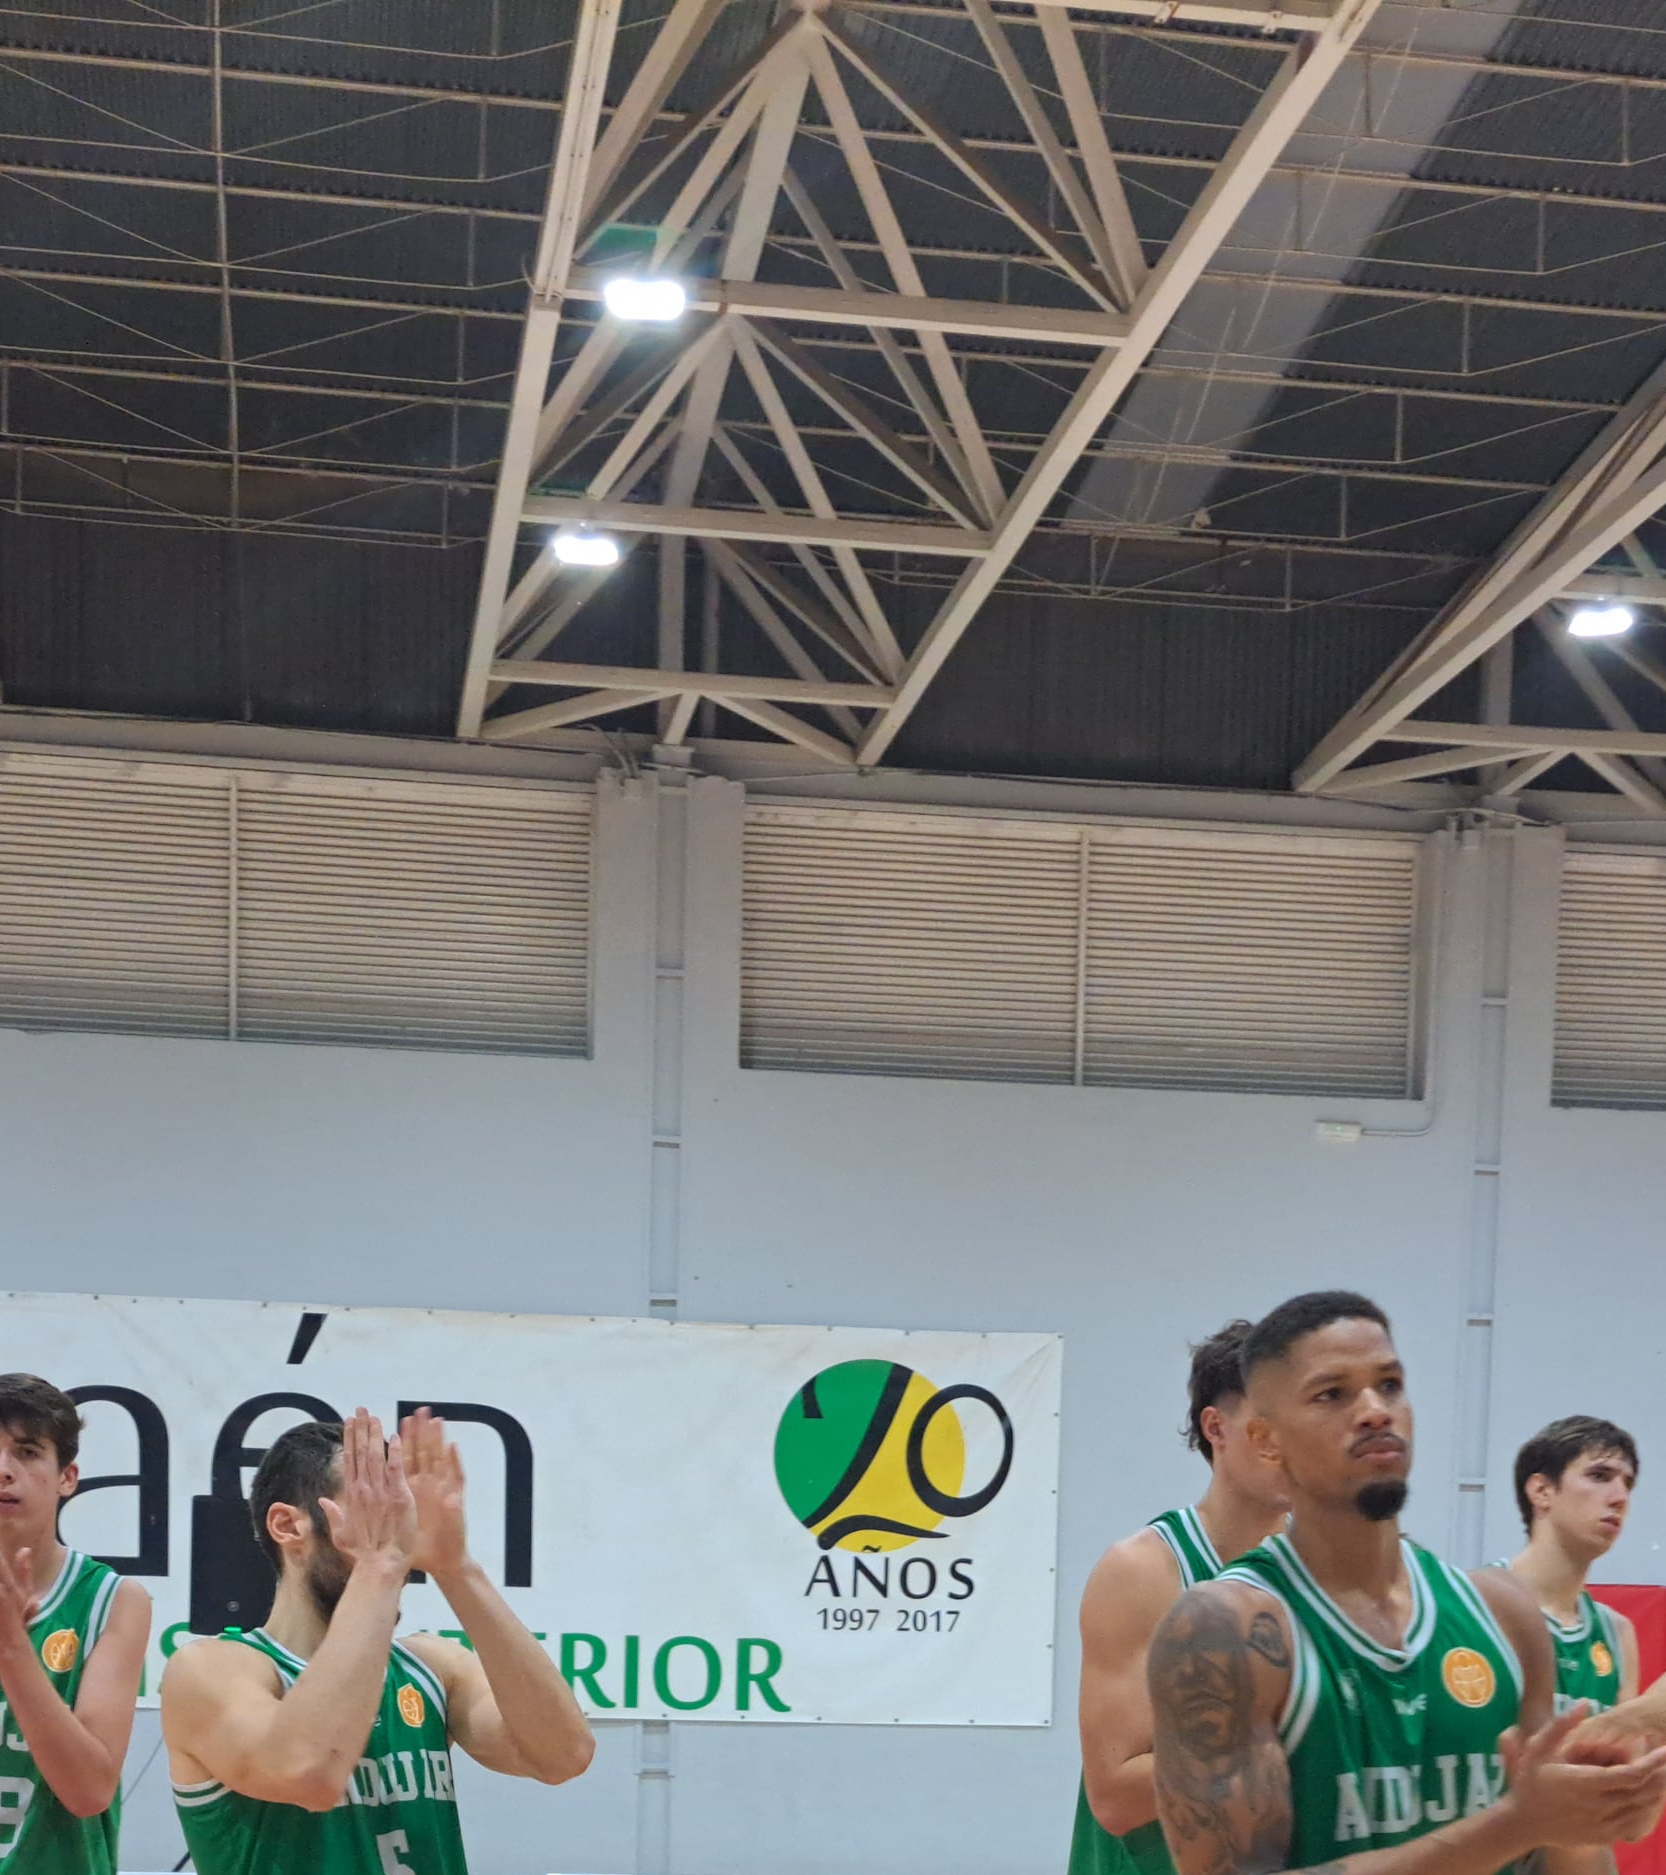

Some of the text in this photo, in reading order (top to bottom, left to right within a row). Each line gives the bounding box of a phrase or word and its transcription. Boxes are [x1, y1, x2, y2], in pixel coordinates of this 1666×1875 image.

[804, 1545, 975, 1600] AÑOS
[816, 1608, 960, 1633] 1997 2017
